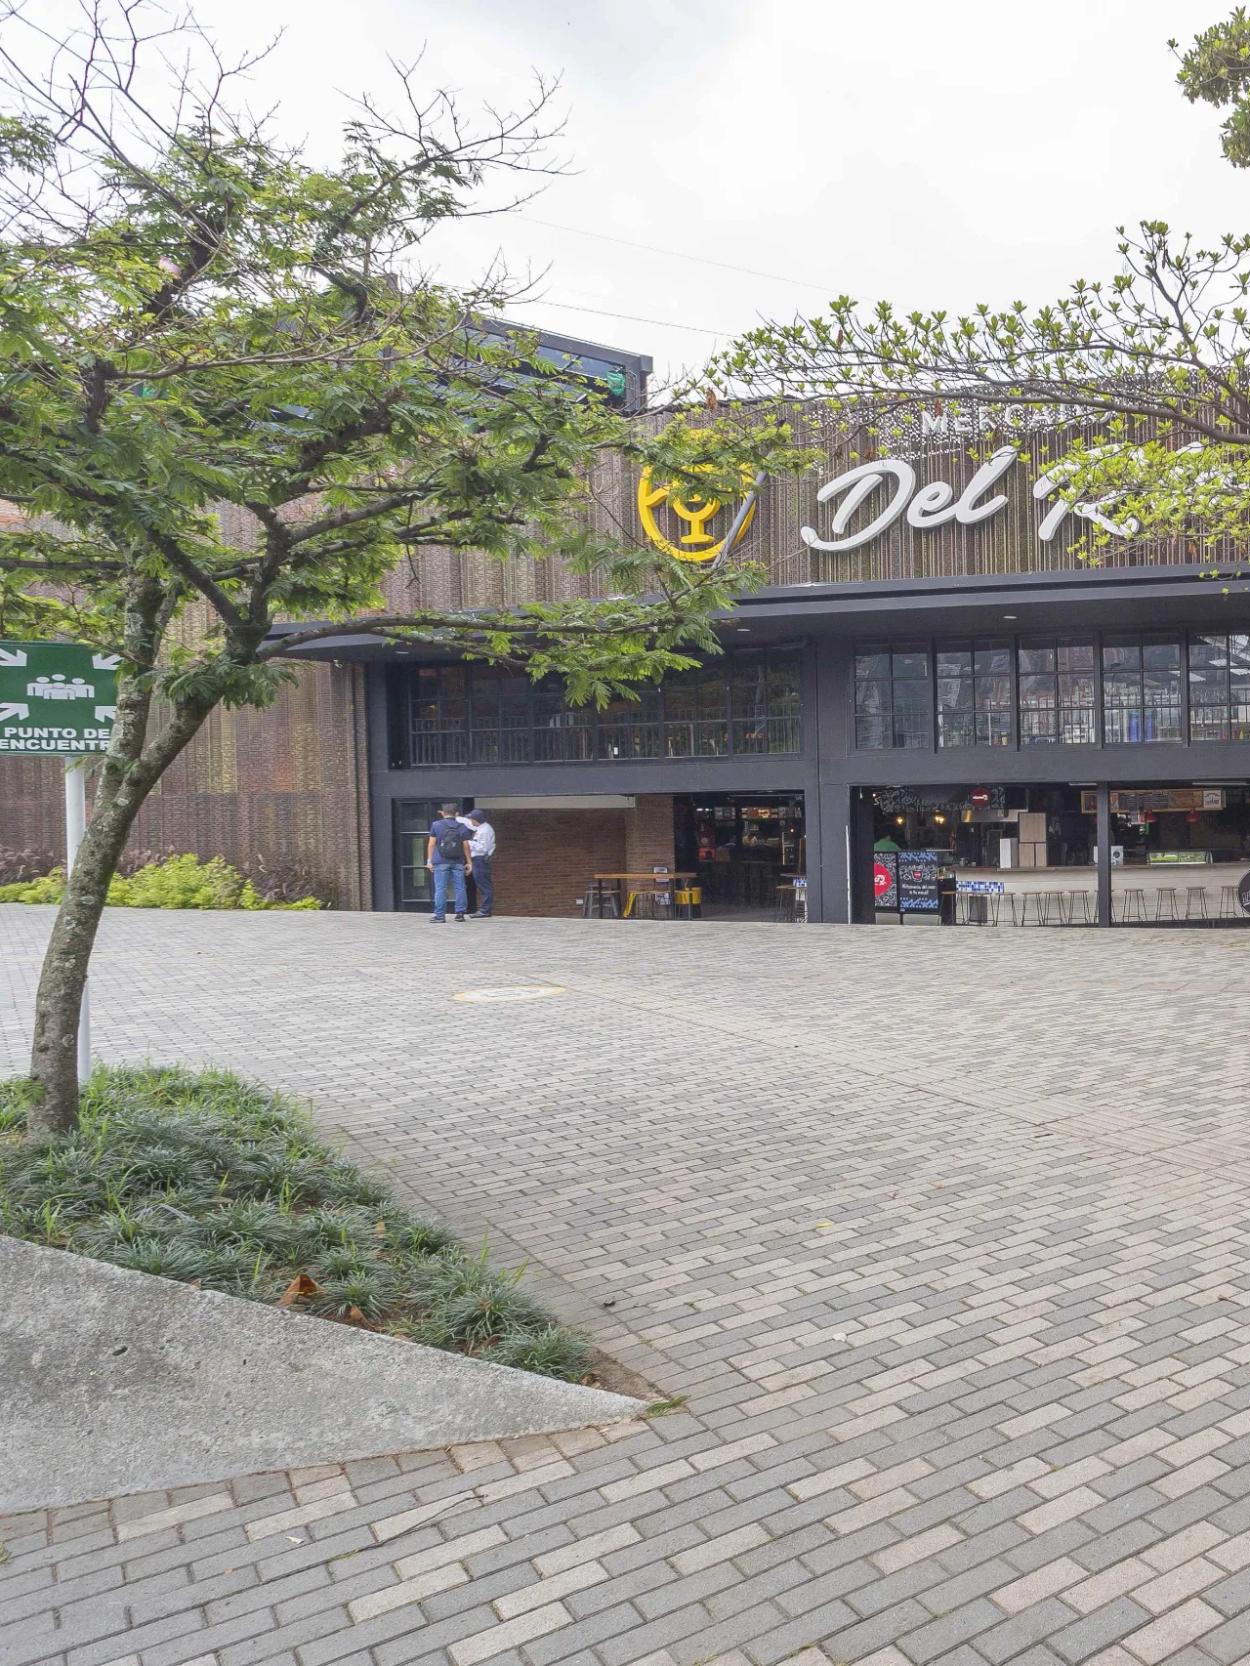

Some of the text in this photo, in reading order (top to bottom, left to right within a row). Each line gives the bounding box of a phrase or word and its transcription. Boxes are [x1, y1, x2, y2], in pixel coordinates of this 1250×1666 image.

[801, 445, 1018, 552] Del
[4, 727, 110, 739] PUNTO DE
[0, 739, 110, 751] ENCUENTR
